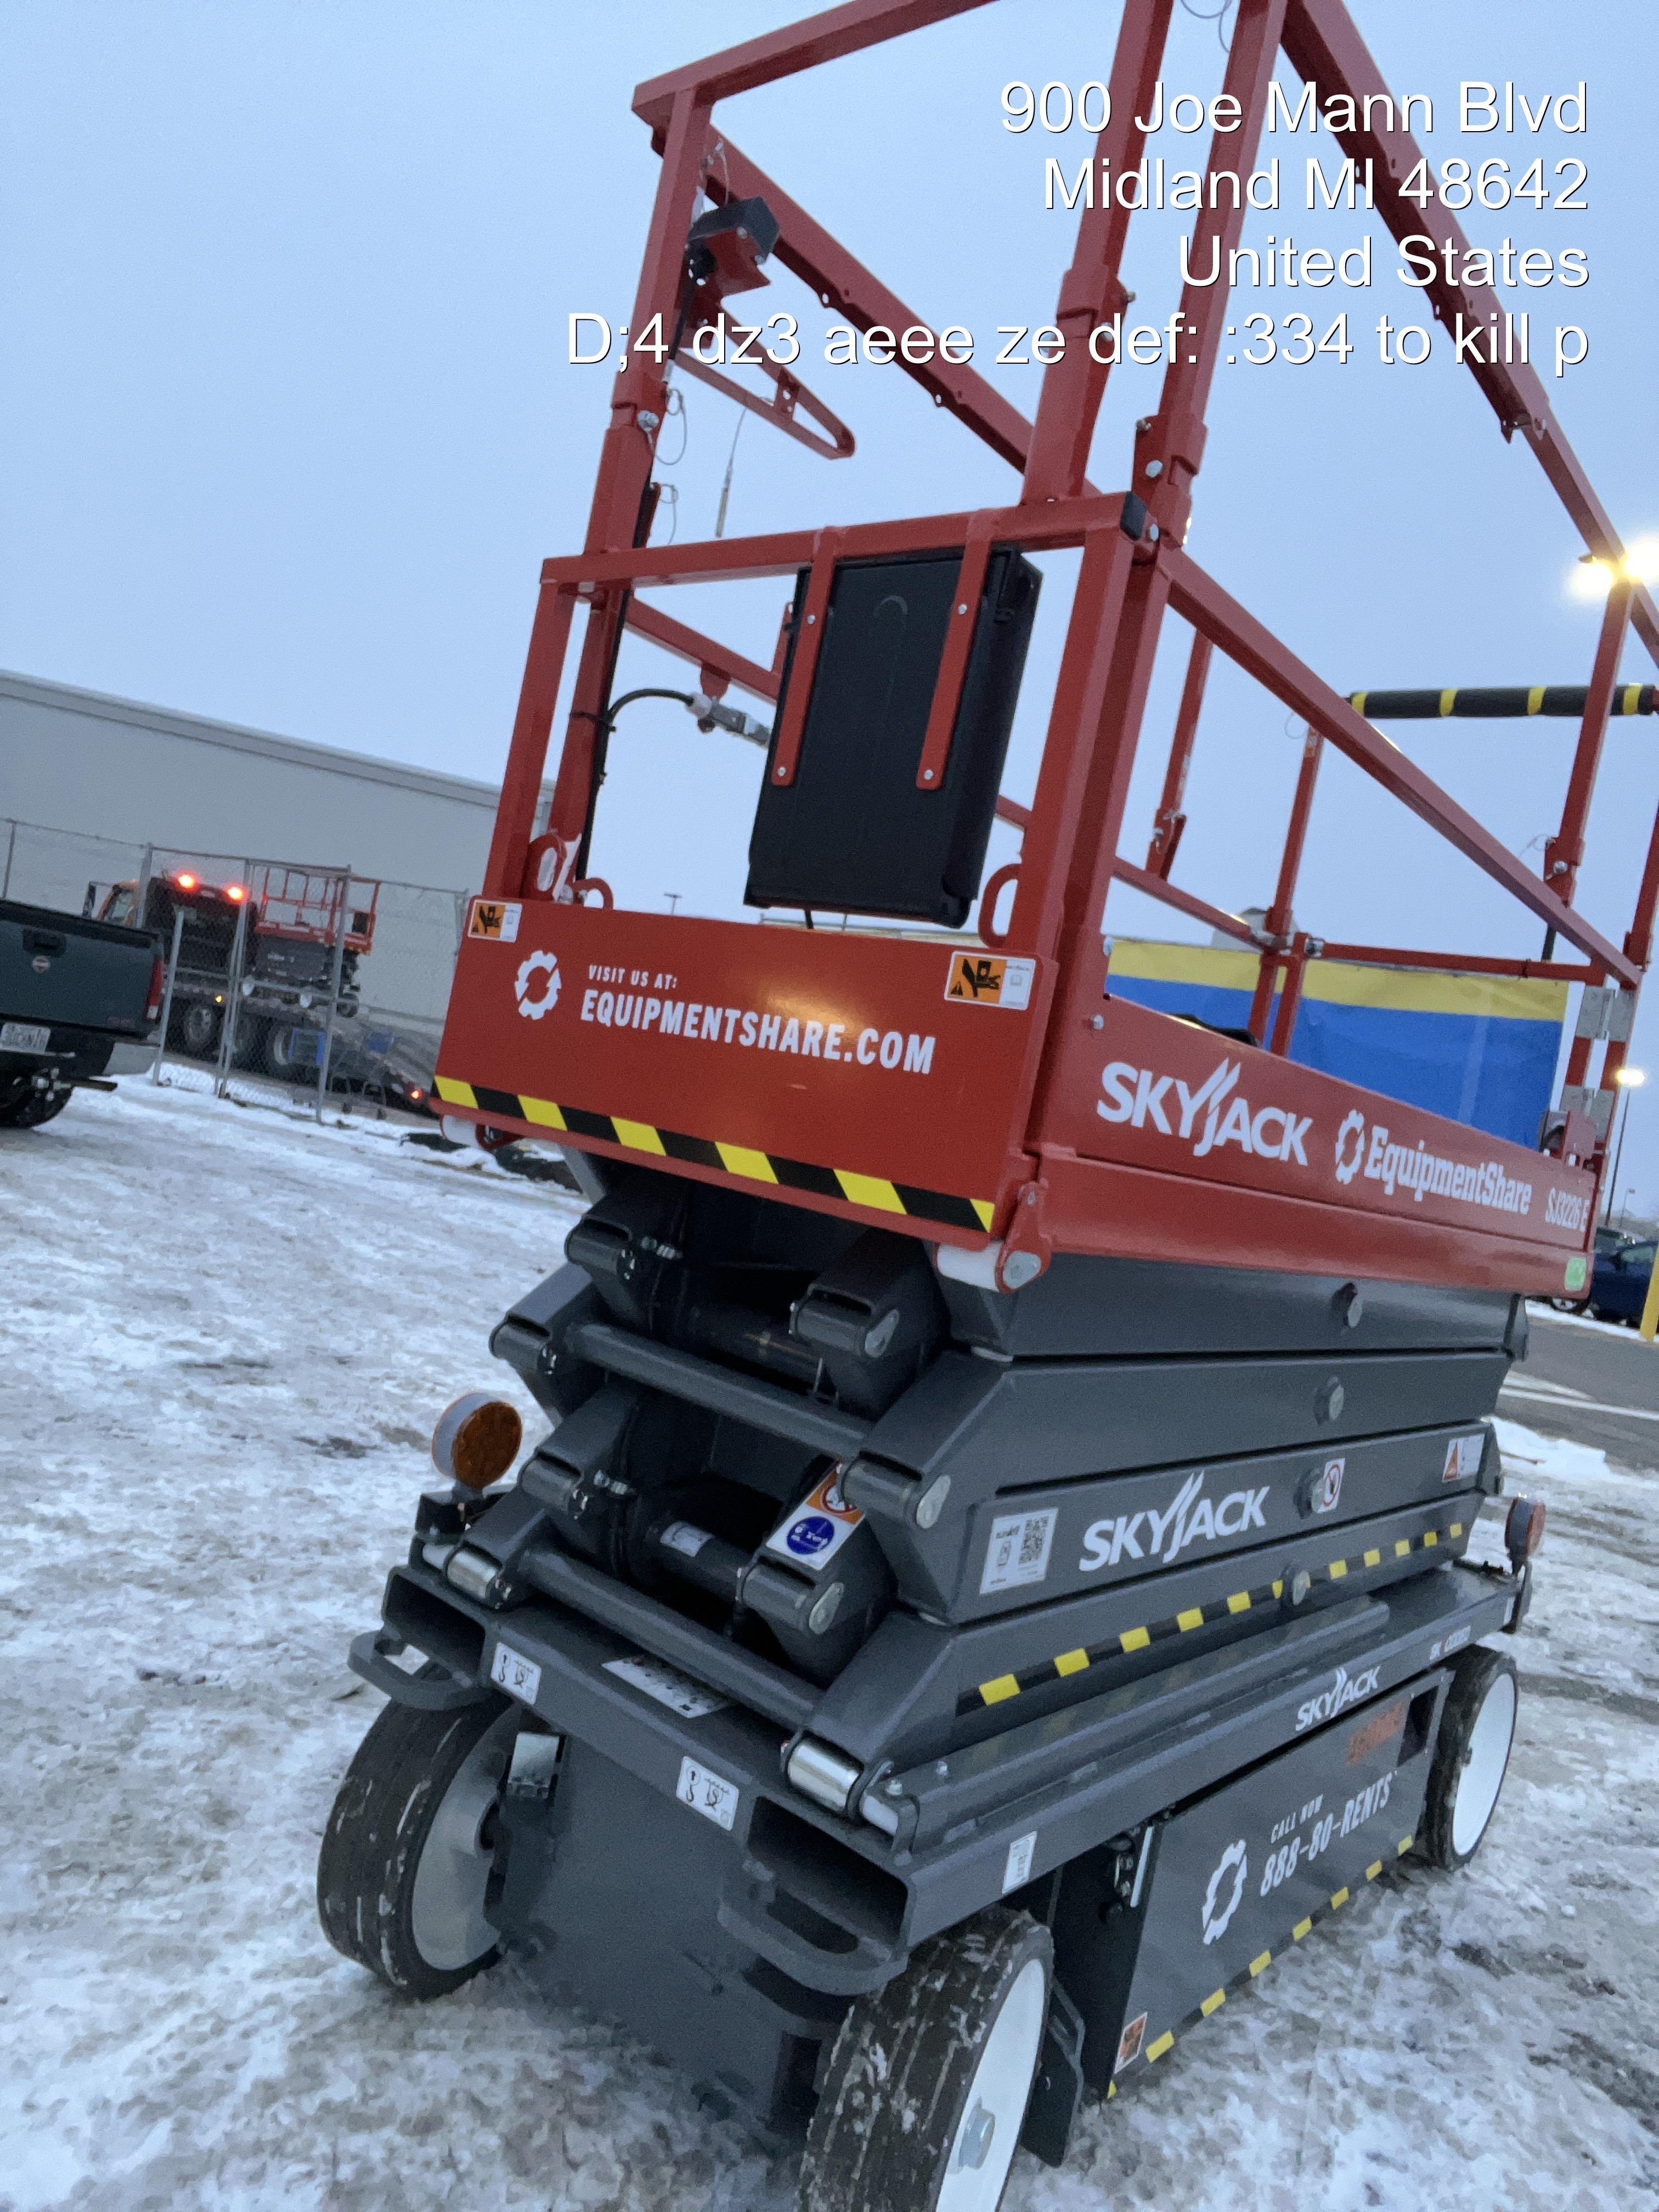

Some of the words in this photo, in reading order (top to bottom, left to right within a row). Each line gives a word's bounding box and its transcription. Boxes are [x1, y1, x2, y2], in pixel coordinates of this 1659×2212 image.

[588, 964, 625, 984] VISIT
[631, 969, 648, 987] US
[654, 973, 678, 990] AT:
[580, 989, 936, 1074] EQUIPMENTSHARE.COM
[1097, 1057, 1313, 1166] SKYJACK
[1364, 1125, 1533, 1215] EquipmentShare
[1079, 1470, 1270, 1571] SKYJACK
[1295, 1666, 1380, 1731] SKYJACK
[1260, 1772, 1393, 1897] 888-80-RENTS
[1271, 1812, 1296, 1844] CALL
